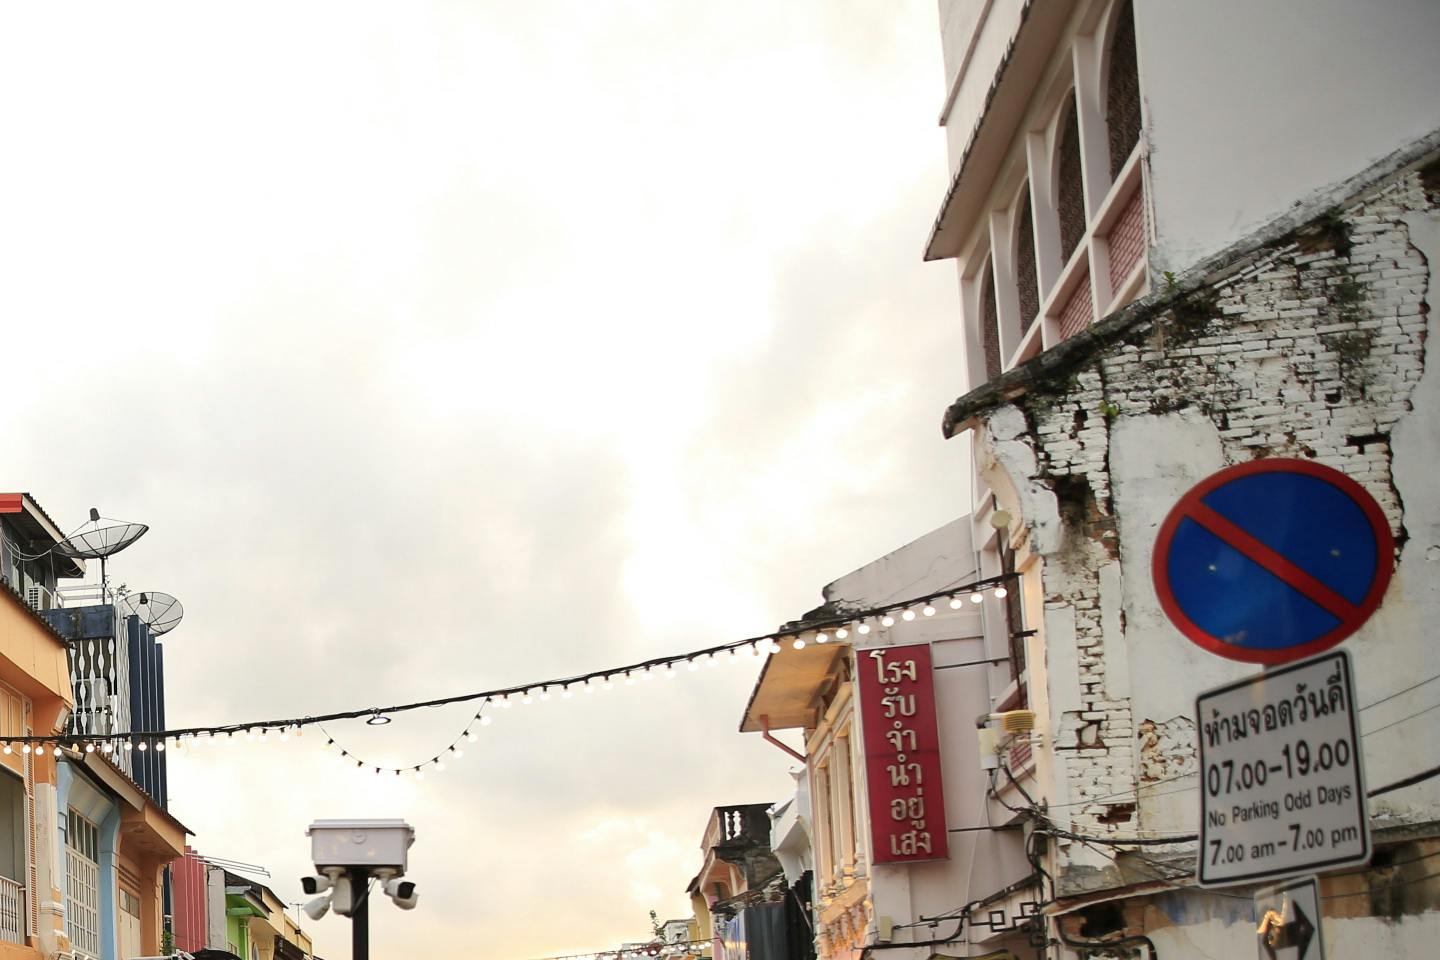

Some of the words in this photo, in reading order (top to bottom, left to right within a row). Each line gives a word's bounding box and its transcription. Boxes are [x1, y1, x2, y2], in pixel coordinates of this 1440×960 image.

[869, 649, 917, 684] โรง
[881, 687, 916, 718] รับ
[1205, 660, 1345, 747] ห้ามจอดวันคี่
[886, 721, 917, 751] จำ
[887, 754, 922, 787] นำ
[1208, 739, 1350, 797] 07.00-19.00
[891, 788, 926, 830] อยู่
[1209, 811, 1226, 828] No
[1232, 800, 1279, 824] Parking
[1284, 790, 1310, 812] Odd
[1318, 783, 1352, 806] Days
[1210, 839, 1244, 866] 7.00
[1331, 825, 1358, 848] pm
